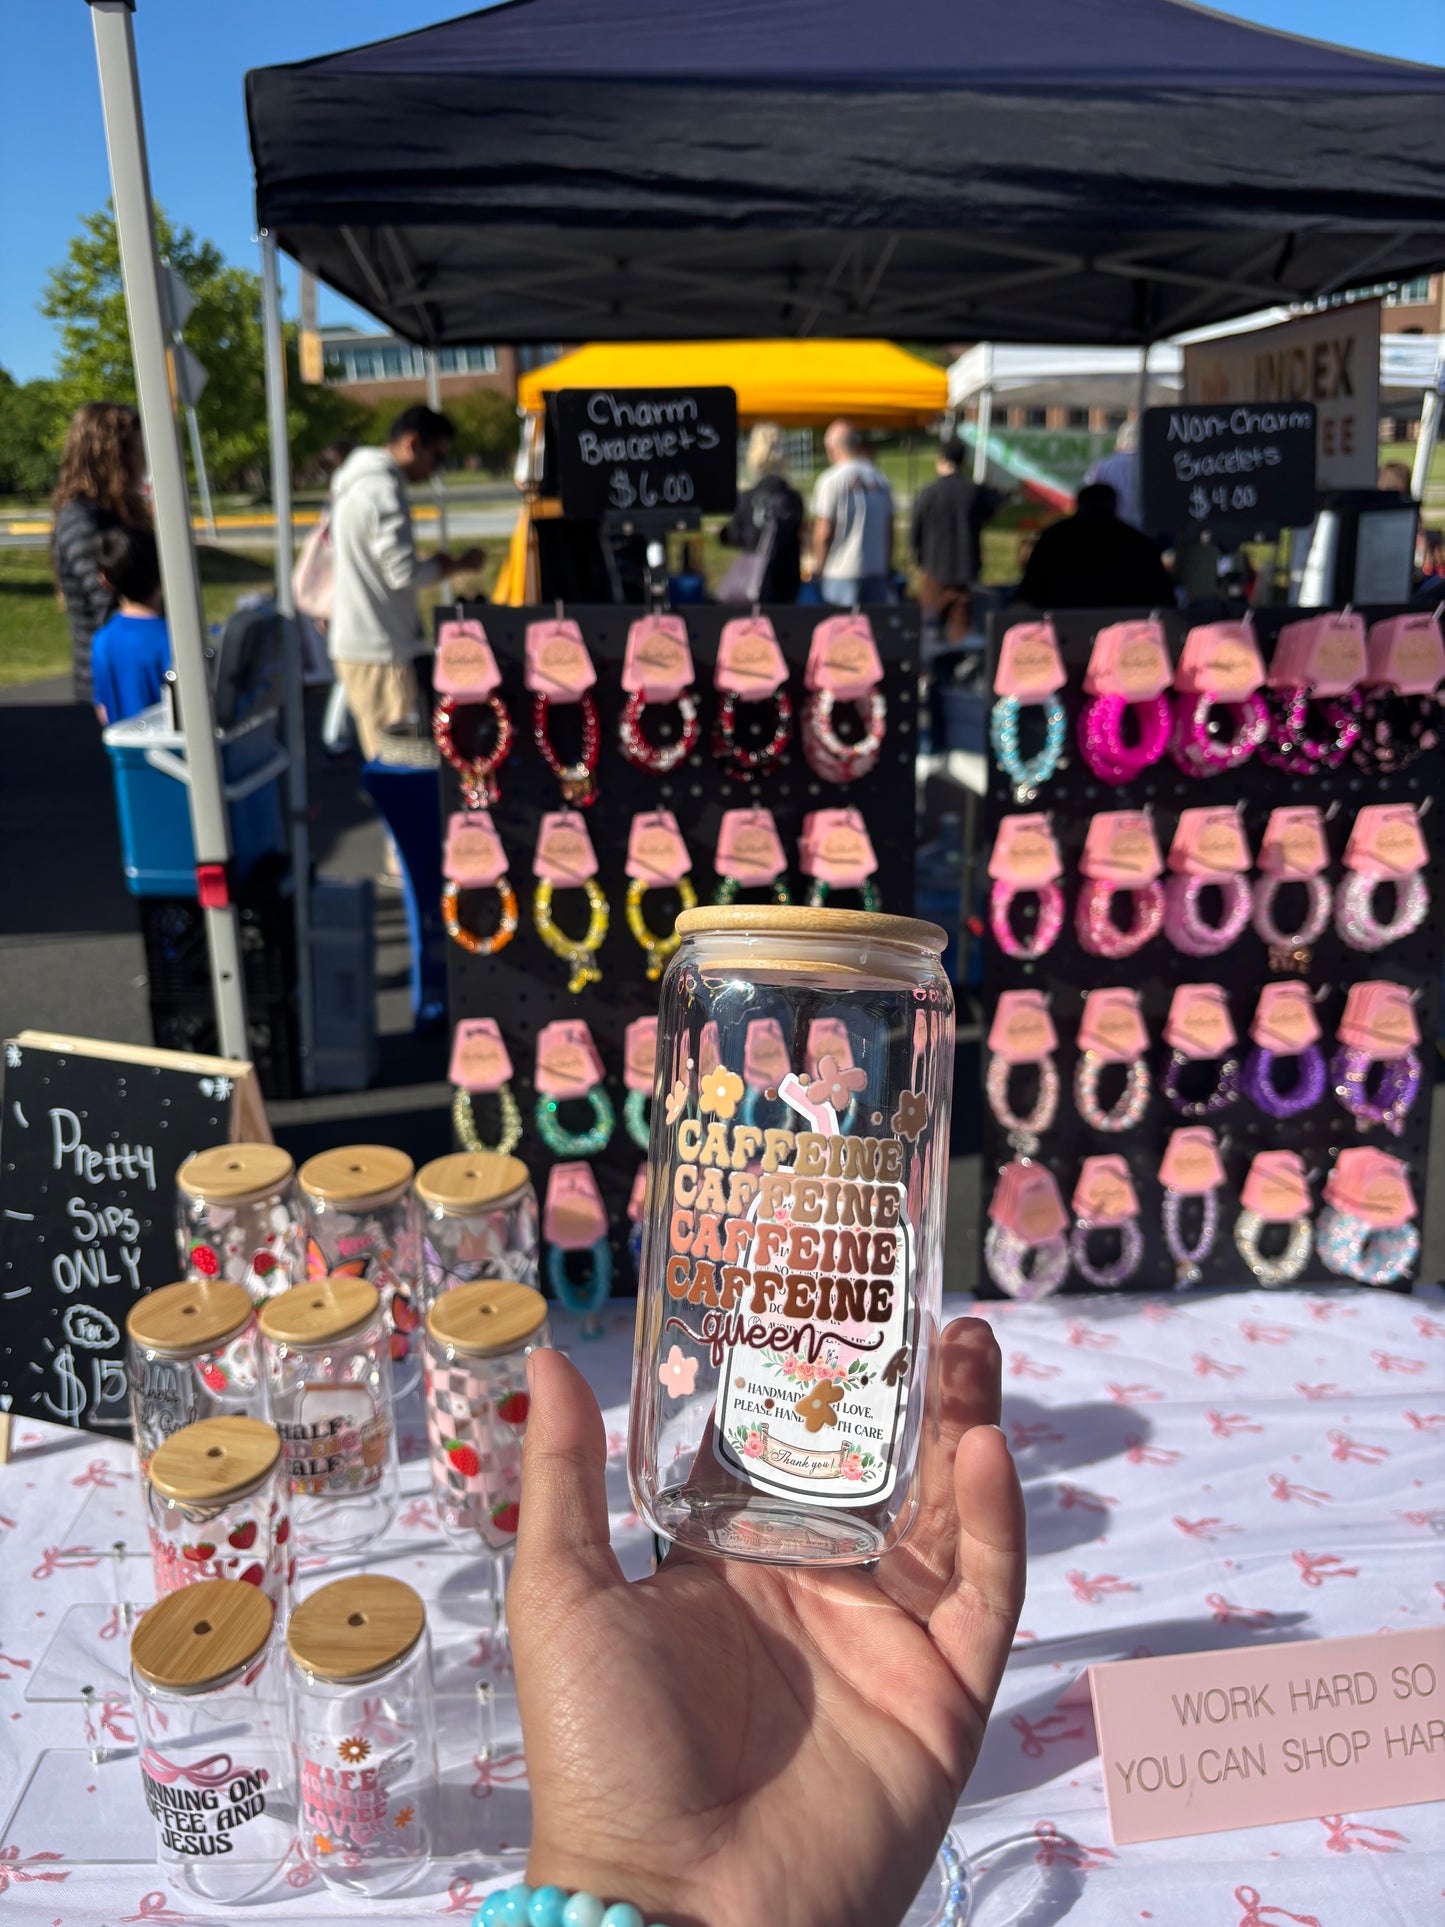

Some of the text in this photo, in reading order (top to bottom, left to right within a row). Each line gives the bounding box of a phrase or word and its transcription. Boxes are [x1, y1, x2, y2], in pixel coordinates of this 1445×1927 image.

[1254, 335, 1356, 400] INDEX
[587, 392, 698, 427] Charm
[1173, 446, 1283, 482] Bracelets
[48, 1107, 157, 1191] Pretty
[677, 1119, 903, 1184] CAFFEINE
[673, 1164, 901, 1229] CAFFEINE
[53, 1245, 141, 1295] ONLY
[670, 1210, 897, 1276] CAFFEINE
[666, 1255, 895, 1323] CAFFEINE
[666, 1310, 884, 1367] queen
[43, 1343, 128, 1428] $15
[770, 1450, 811, 1469] Thank
[854, 1424, 884, 1441] CARE
[1171, 1663, 1437, 1727] WORK HARD SO
[229, 1769, 262, 1803] ON
[1114, 1719, 1445, 1794] YOU CAN SHOP HAR
[161, 1827, 233, 1856] JESUS
[217, 1792, 265, 1831] AND
